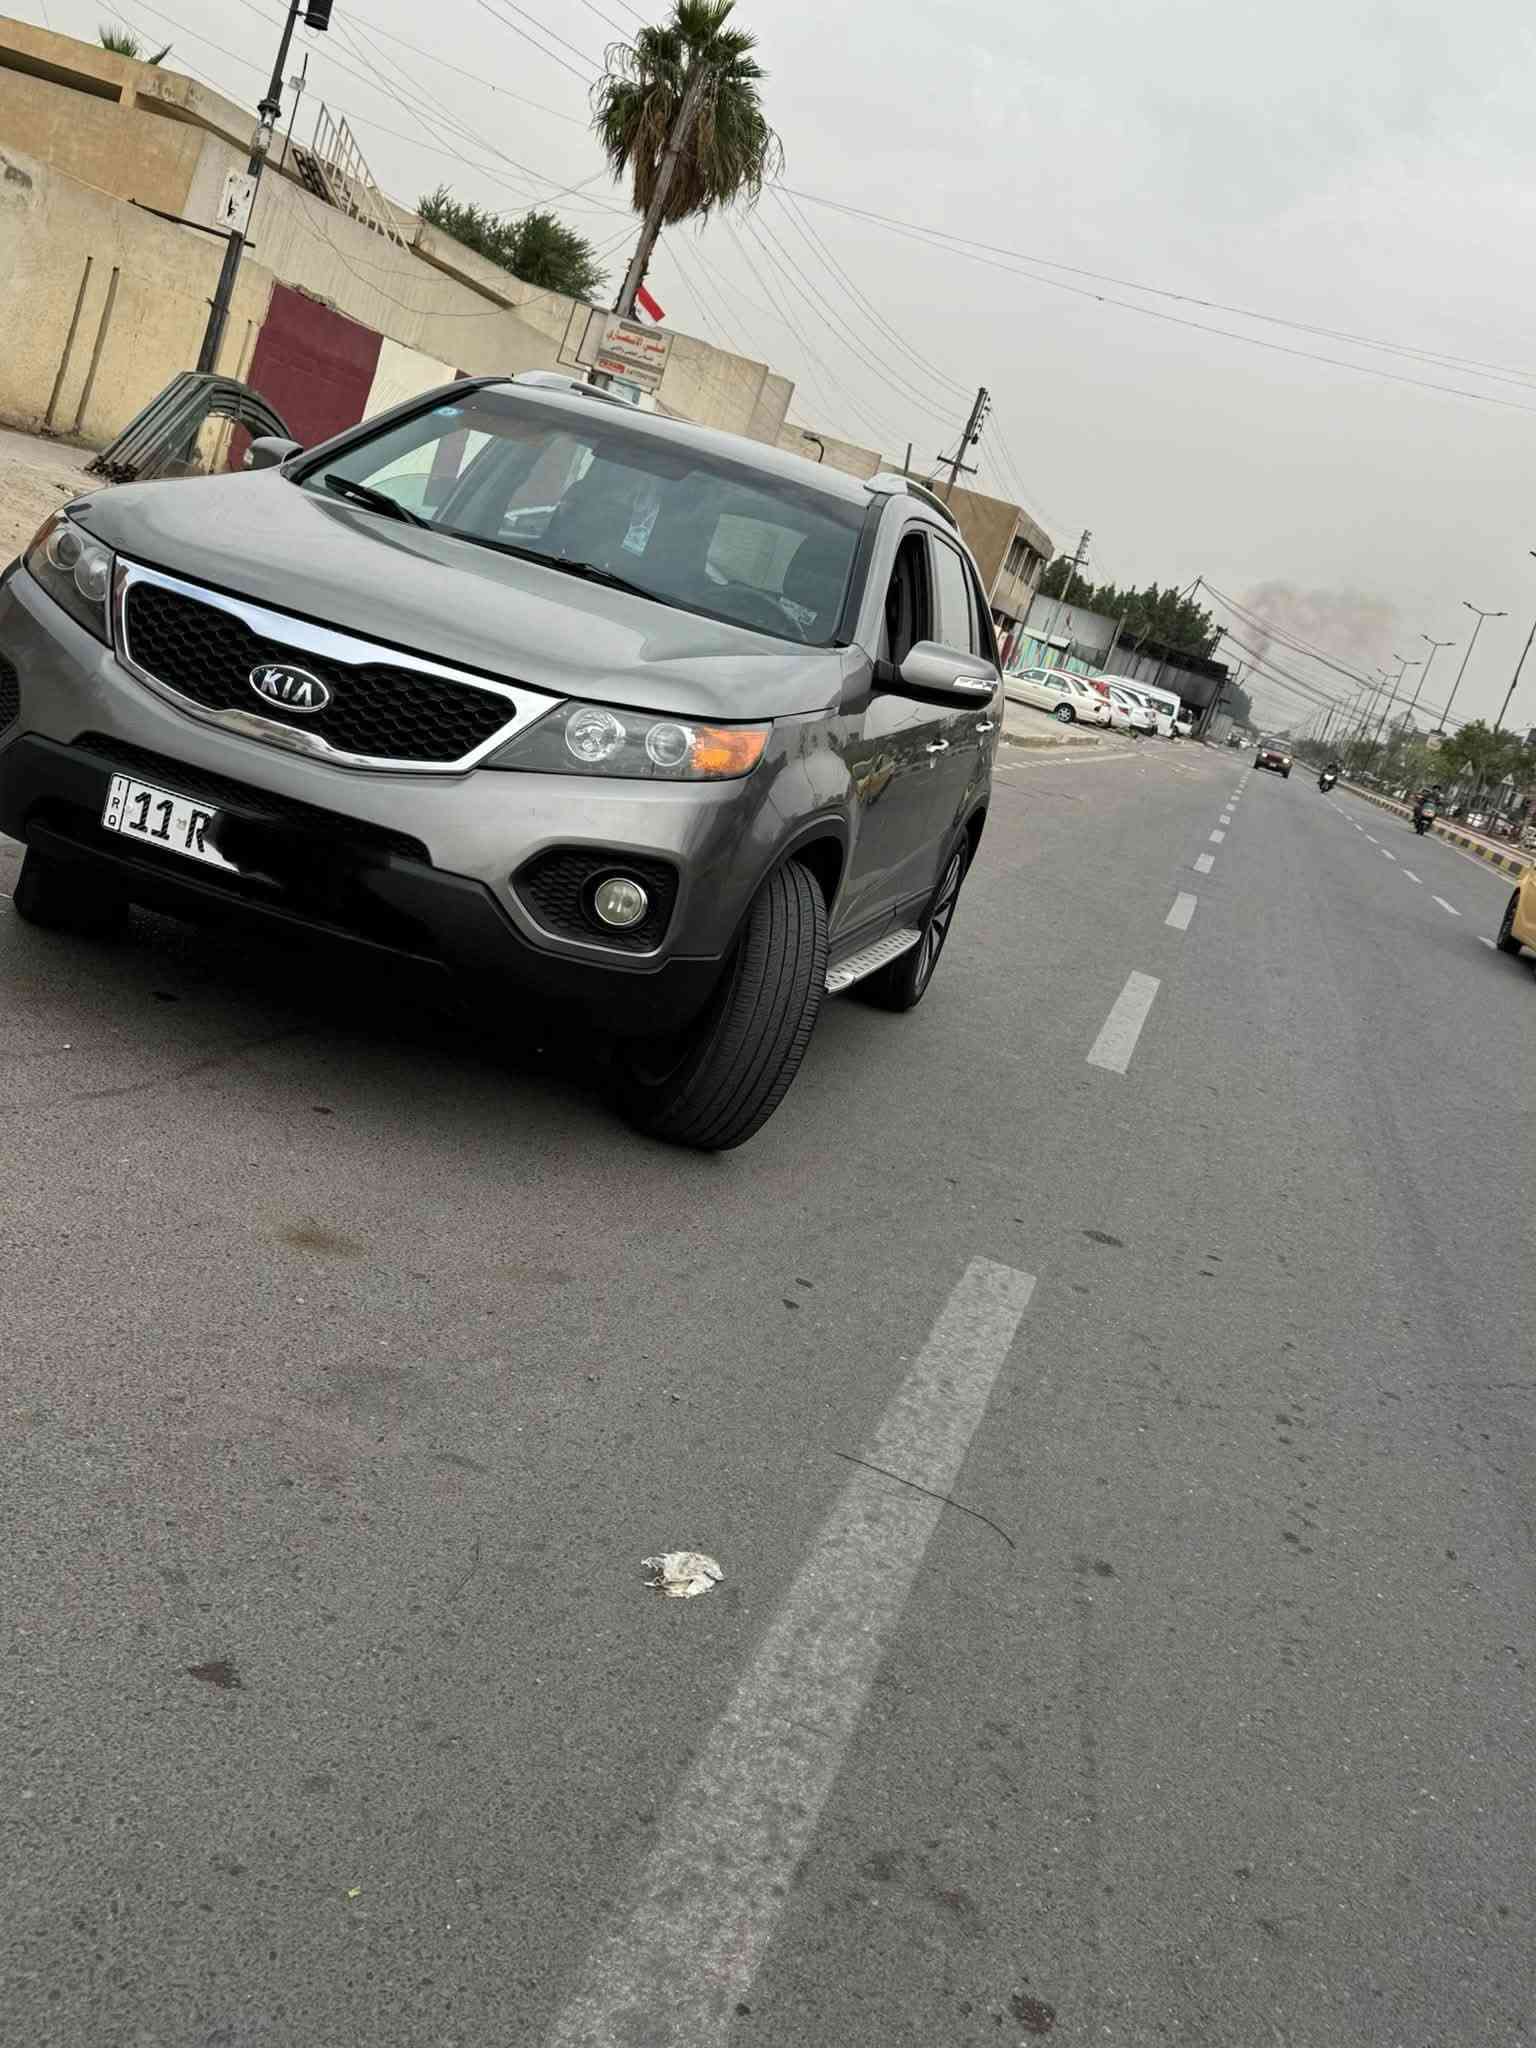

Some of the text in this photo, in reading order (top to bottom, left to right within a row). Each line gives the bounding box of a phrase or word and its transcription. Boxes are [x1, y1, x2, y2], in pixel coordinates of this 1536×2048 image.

[260, 668, 313, 707] KIA
[107, 780, 123, 827] IRQ
[129, 792, 212, 853] 11 R
